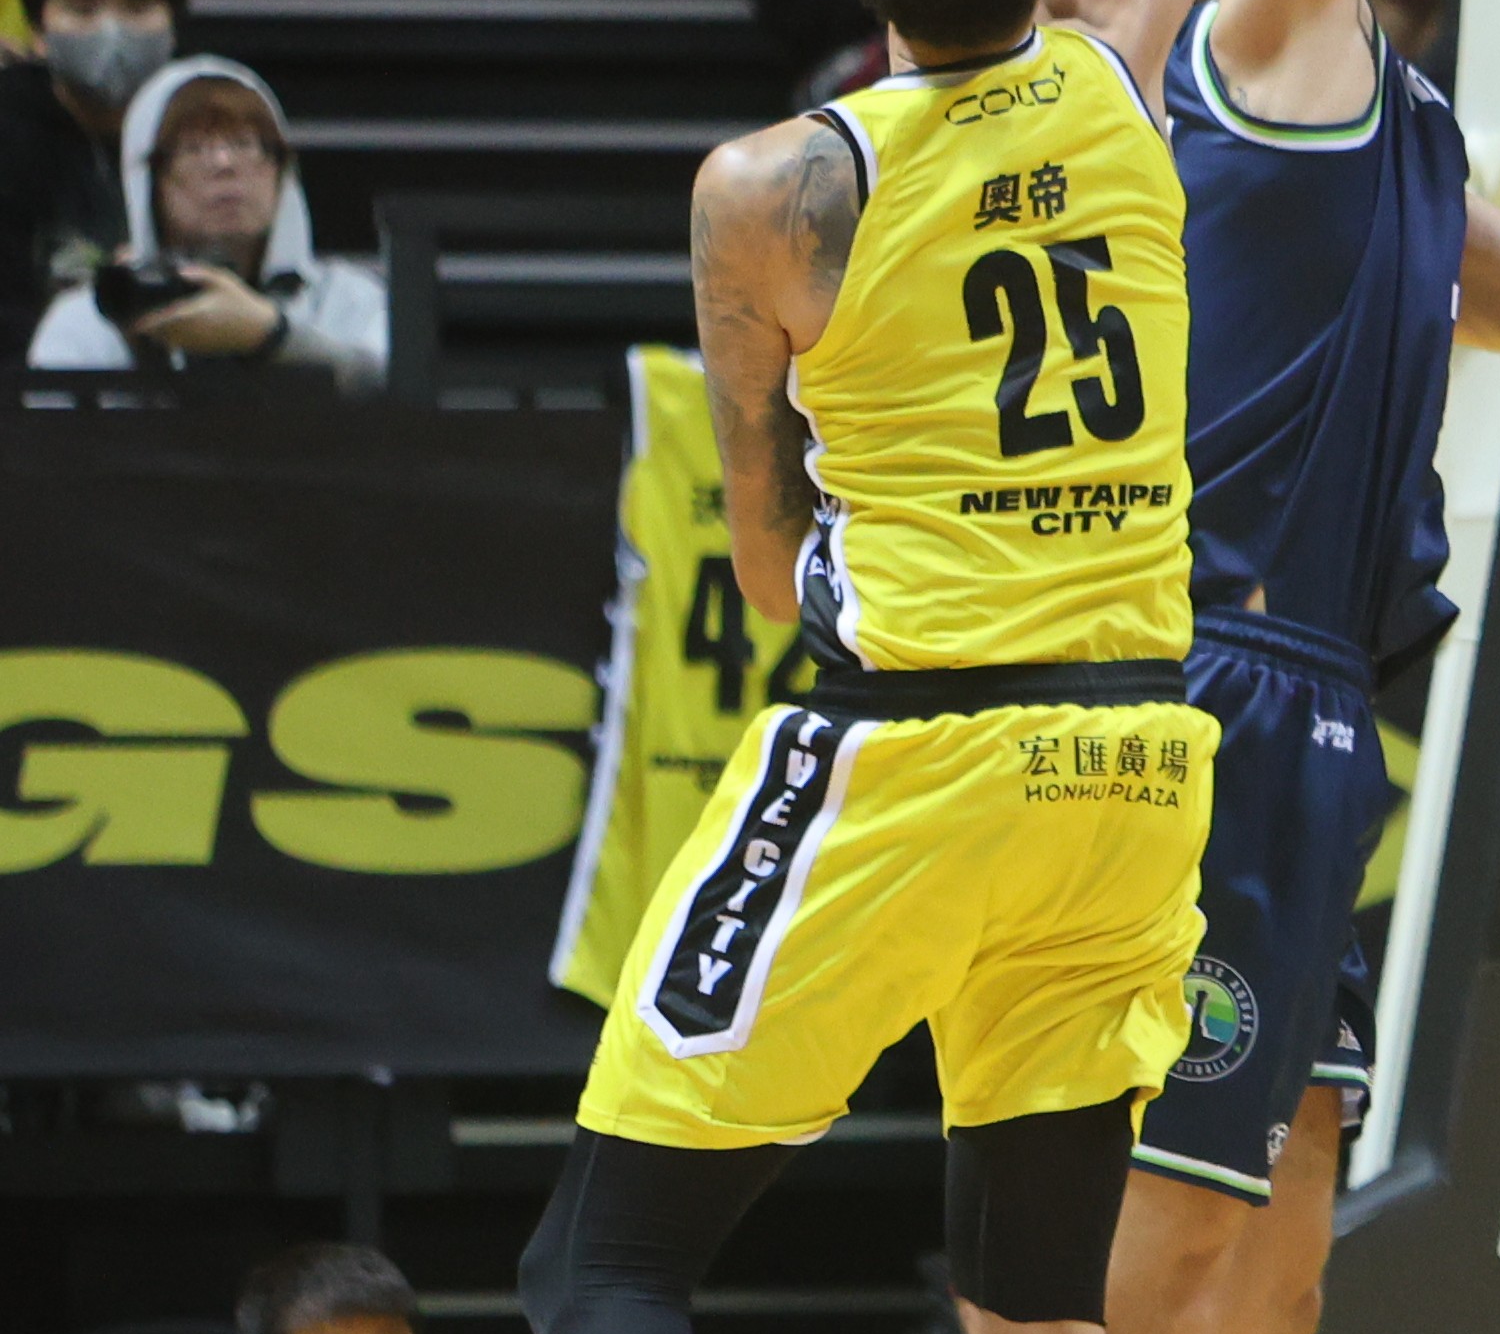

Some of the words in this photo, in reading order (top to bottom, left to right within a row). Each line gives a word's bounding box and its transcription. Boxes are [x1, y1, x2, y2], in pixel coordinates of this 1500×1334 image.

[962, 234, 1146, 457] 25
[960, 486, 1062, 515] NEW
[1069, 483, 1173, 509] TAIPEI
[1031, 509, 1128, 536] CITY
[1108, 782, 1181, 809] PLAZA
